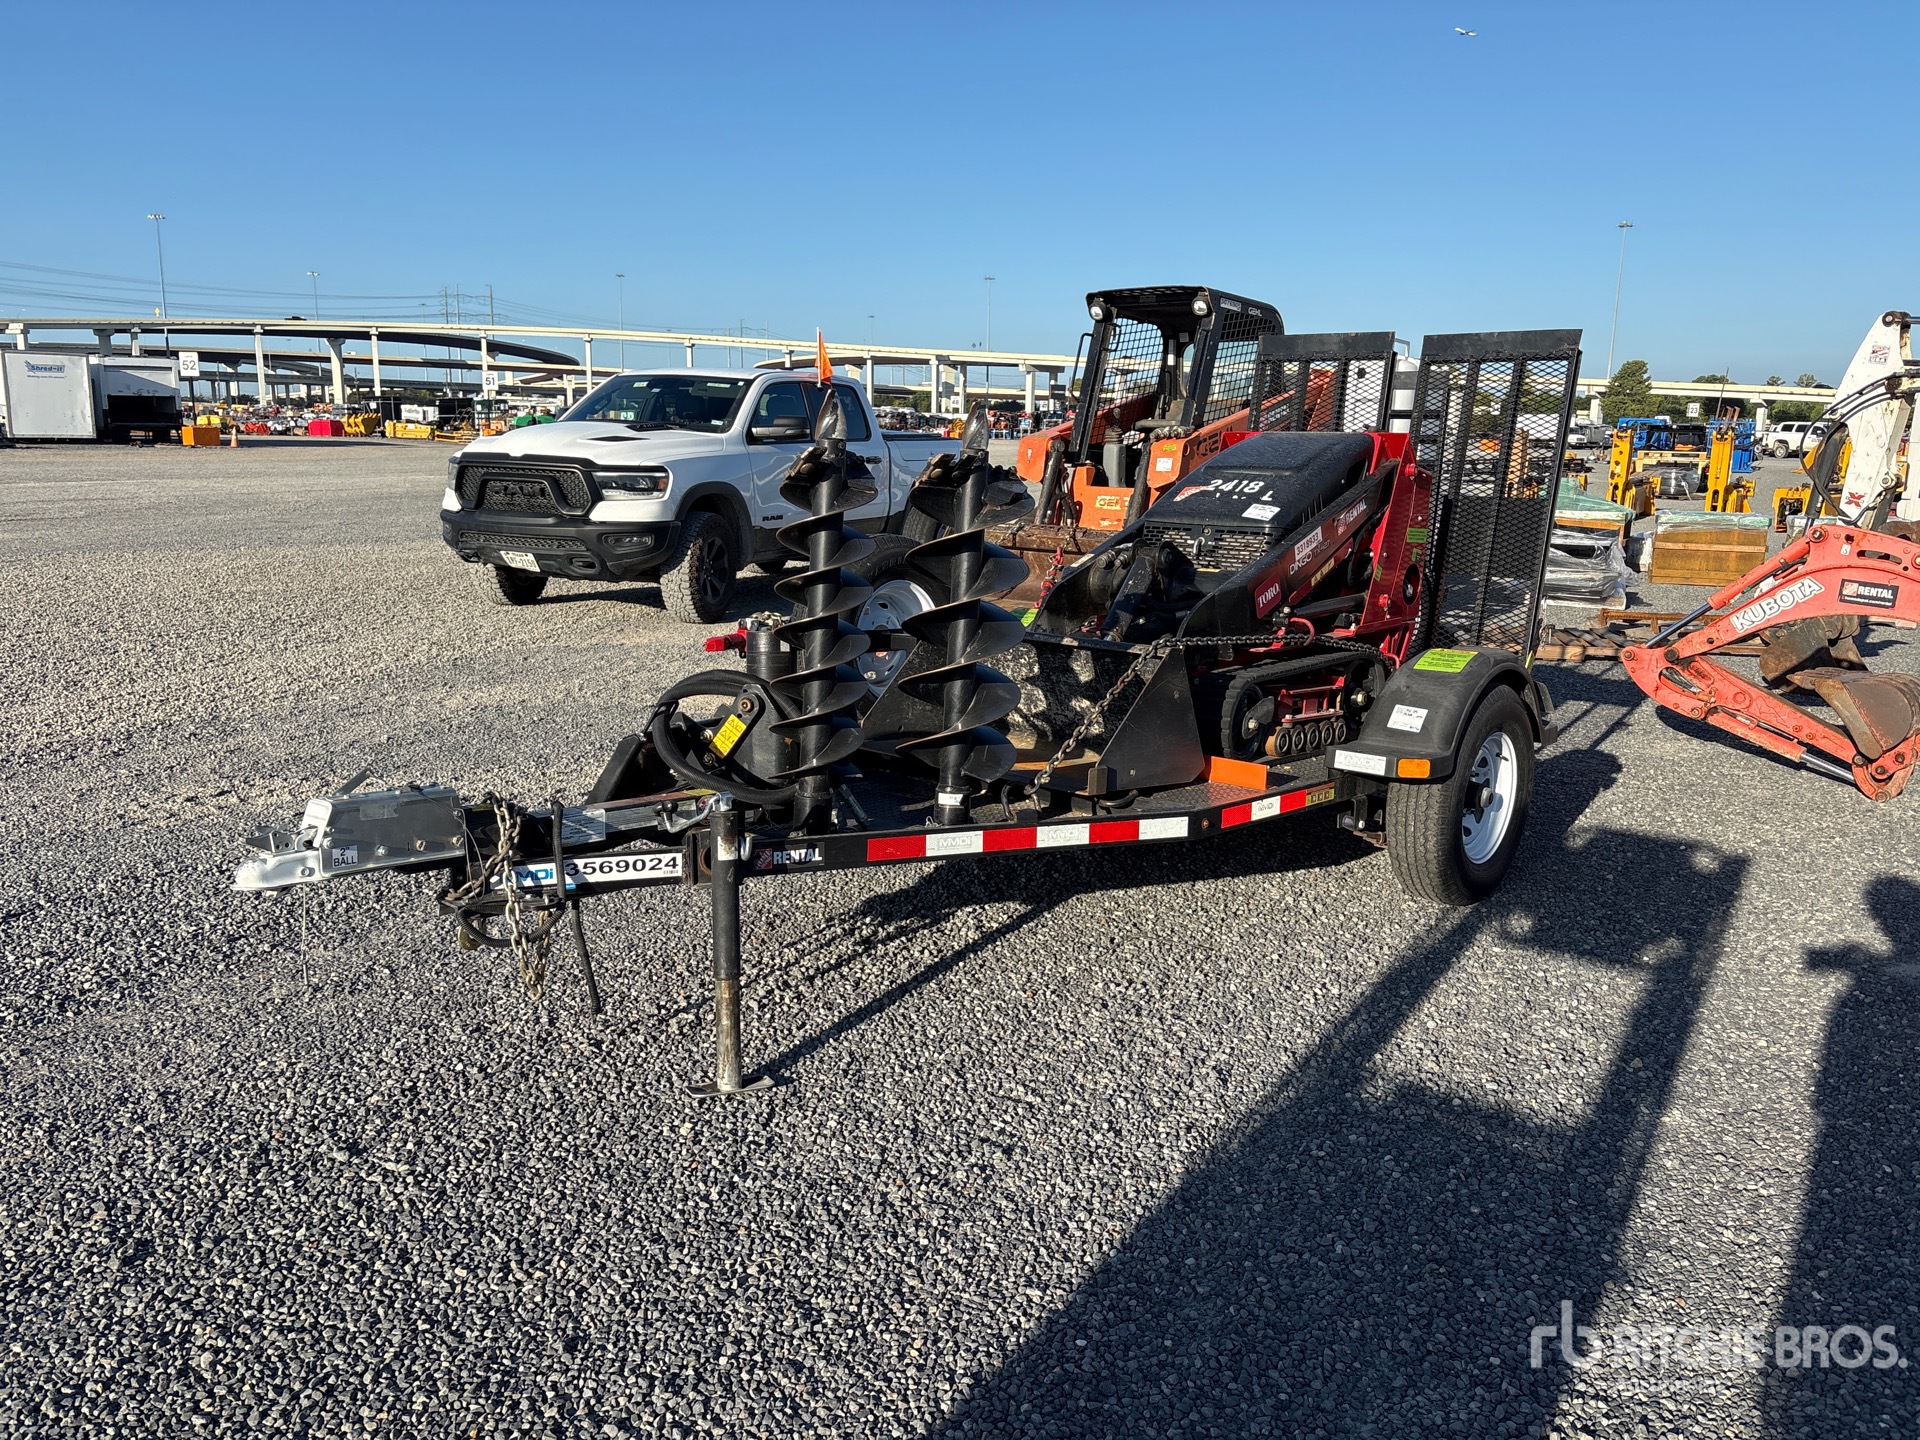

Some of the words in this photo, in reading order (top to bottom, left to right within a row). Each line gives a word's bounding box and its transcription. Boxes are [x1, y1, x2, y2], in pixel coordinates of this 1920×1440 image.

[182, 360, 197, 370] 52
[485, 377, 496, 386] 51
[489, 484, 543, 497] RAM
[1208, 479, 1264, 493] 2418
[1345, 498, 1367, 525] RENTAL
[1296, 532, 1320, 556] 3318933
[1258, 582, 1279, 609] TORO
[1857, 585, 1894, 599] RENTAL
[1730, 577, 1823, 632] KUBOTA
[333, 855, 357, 867] BALL
[773, 847, 823, 865] RENTAL
[565, 856, 679, 877] 3569024
